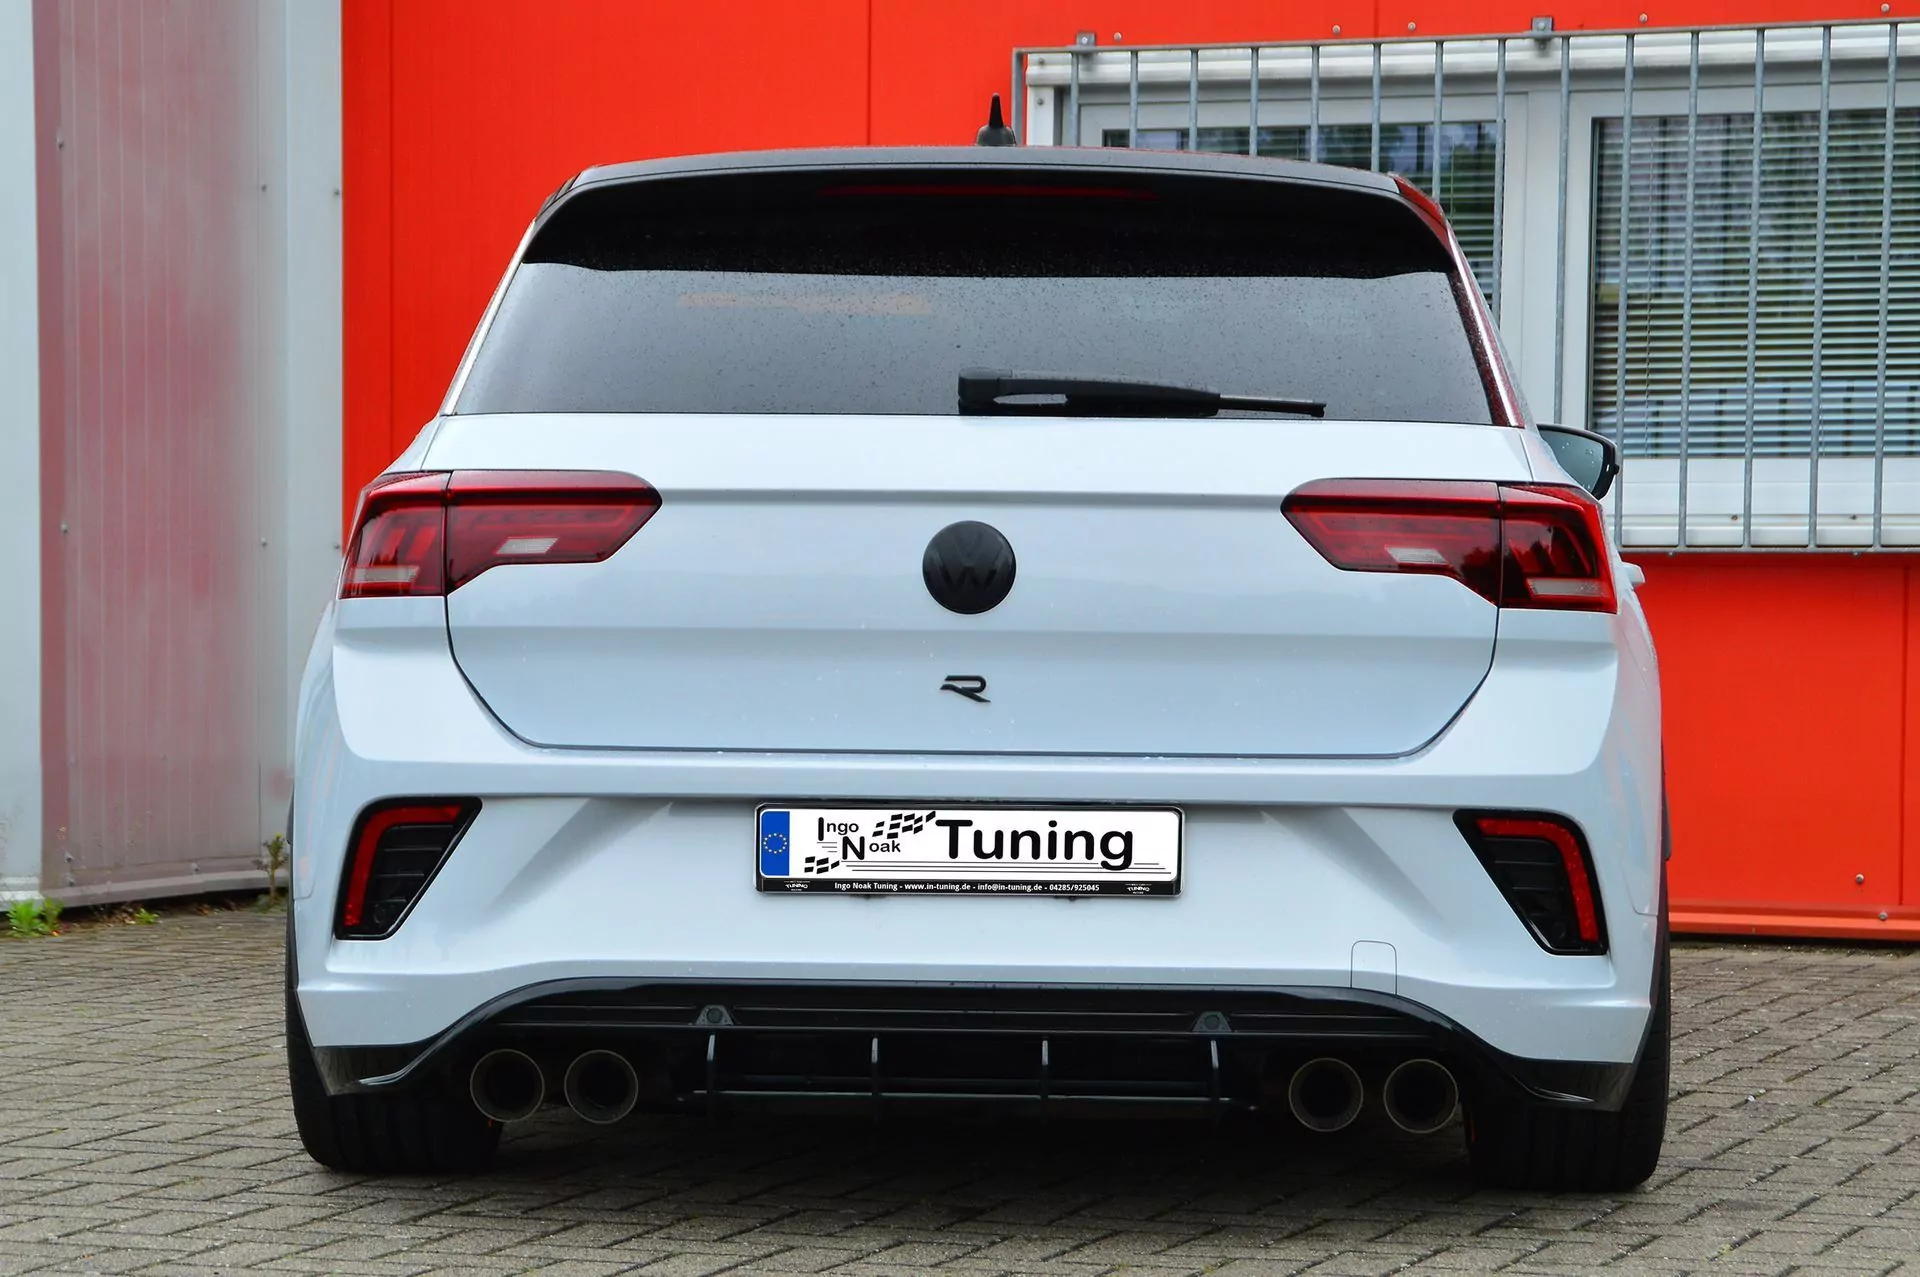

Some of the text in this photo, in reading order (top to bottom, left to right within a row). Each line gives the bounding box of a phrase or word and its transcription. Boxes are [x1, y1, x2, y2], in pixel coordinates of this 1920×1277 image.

[940, 674, 991, 703] R
[817, 816, 860, 842] Ingo
[841, 835, 902, 861] Noak
[934, 819, 1135, 872] Tuning
[834, 882, 851, 892] Ingo
[852, 882, 872, 890] Noak
[873, 882, 898, 892] Tuning
[904, 882, 971, 892] www.in-tuning.de
[977, 883, 1043, 893] info@in-tuning.de
[1049, 883, 1100, 892] 04285/925045
